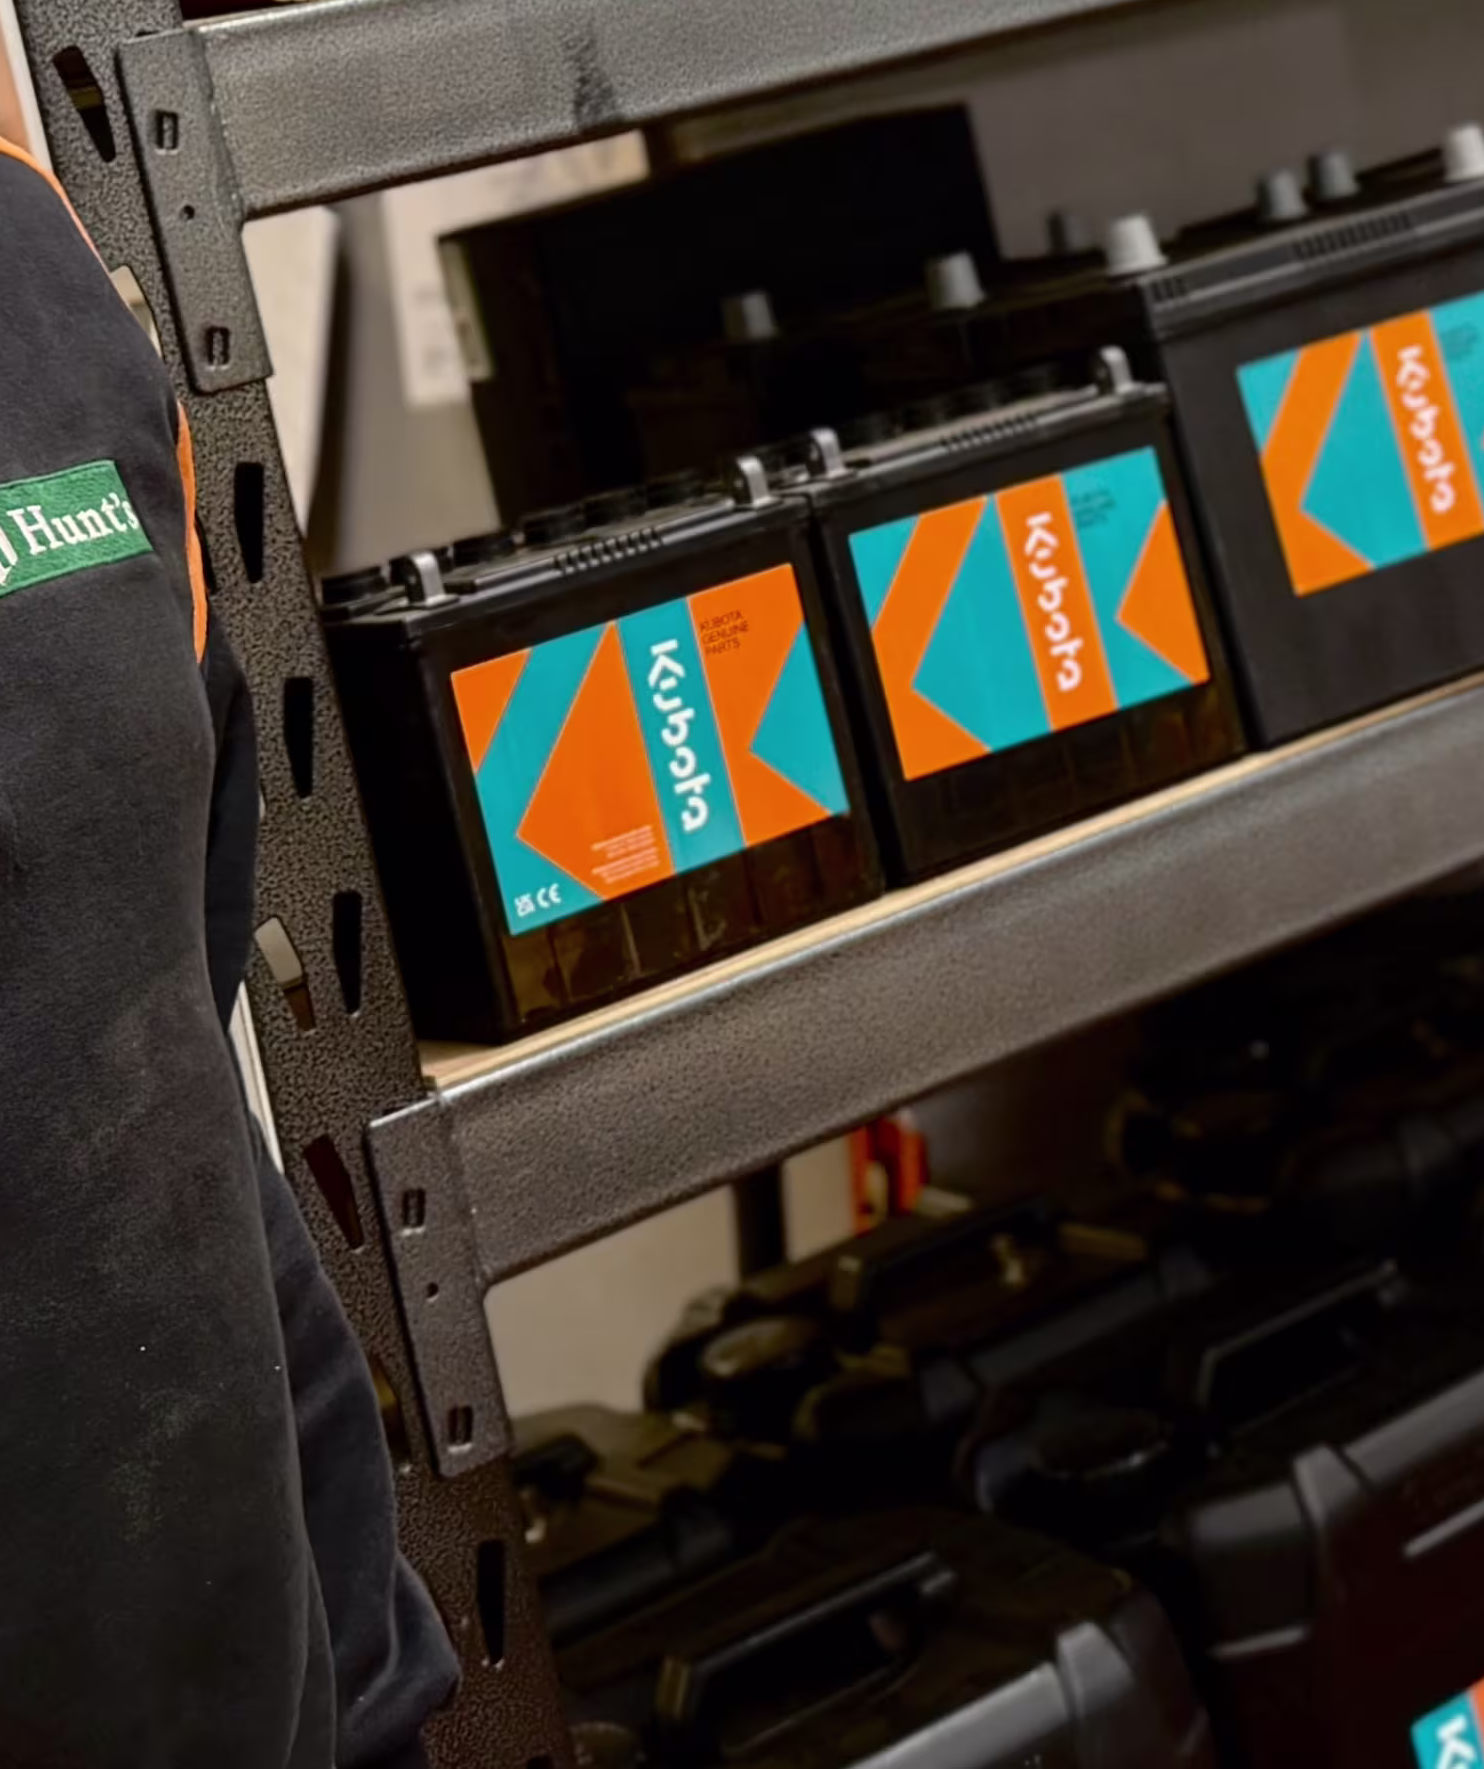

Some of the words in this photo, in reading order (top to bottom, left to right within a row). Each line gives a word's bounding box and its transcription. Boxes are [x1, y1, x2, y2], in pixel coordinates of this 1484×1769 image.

[1396, 344, 1457, 514] Kubota
[1024, 511, 1084, 692] Kubota
[646, 638, 712, 833] Kubota
